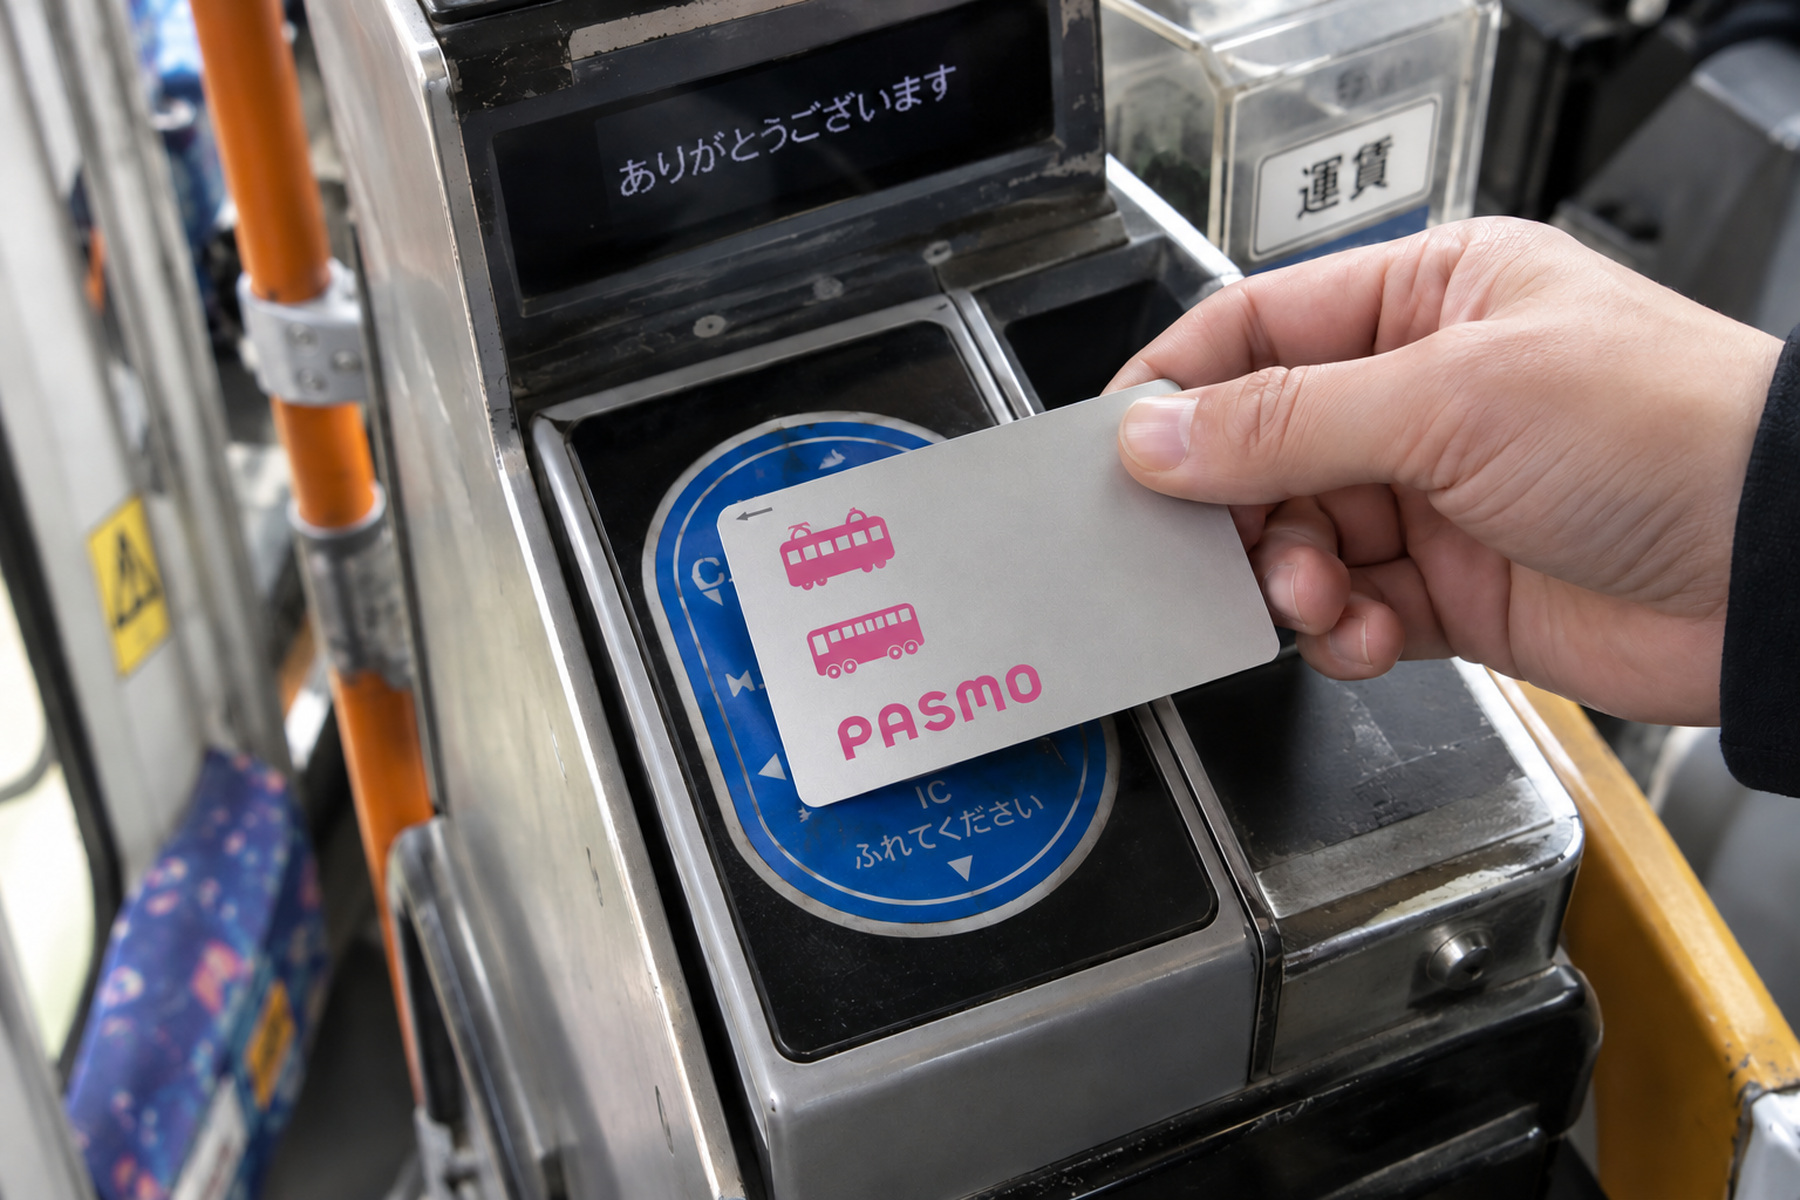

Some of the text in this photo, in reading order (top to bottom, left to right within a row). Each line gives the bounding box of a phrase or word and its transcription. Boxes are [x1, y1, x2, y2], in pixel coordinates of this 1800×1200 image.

[619, 64, 957, 196] ありがとうございます
[837, 663, 1043, 761] PASMO
[855, 795, 1044, 870] ふれてください
[915, 780, 952, 810] IC
